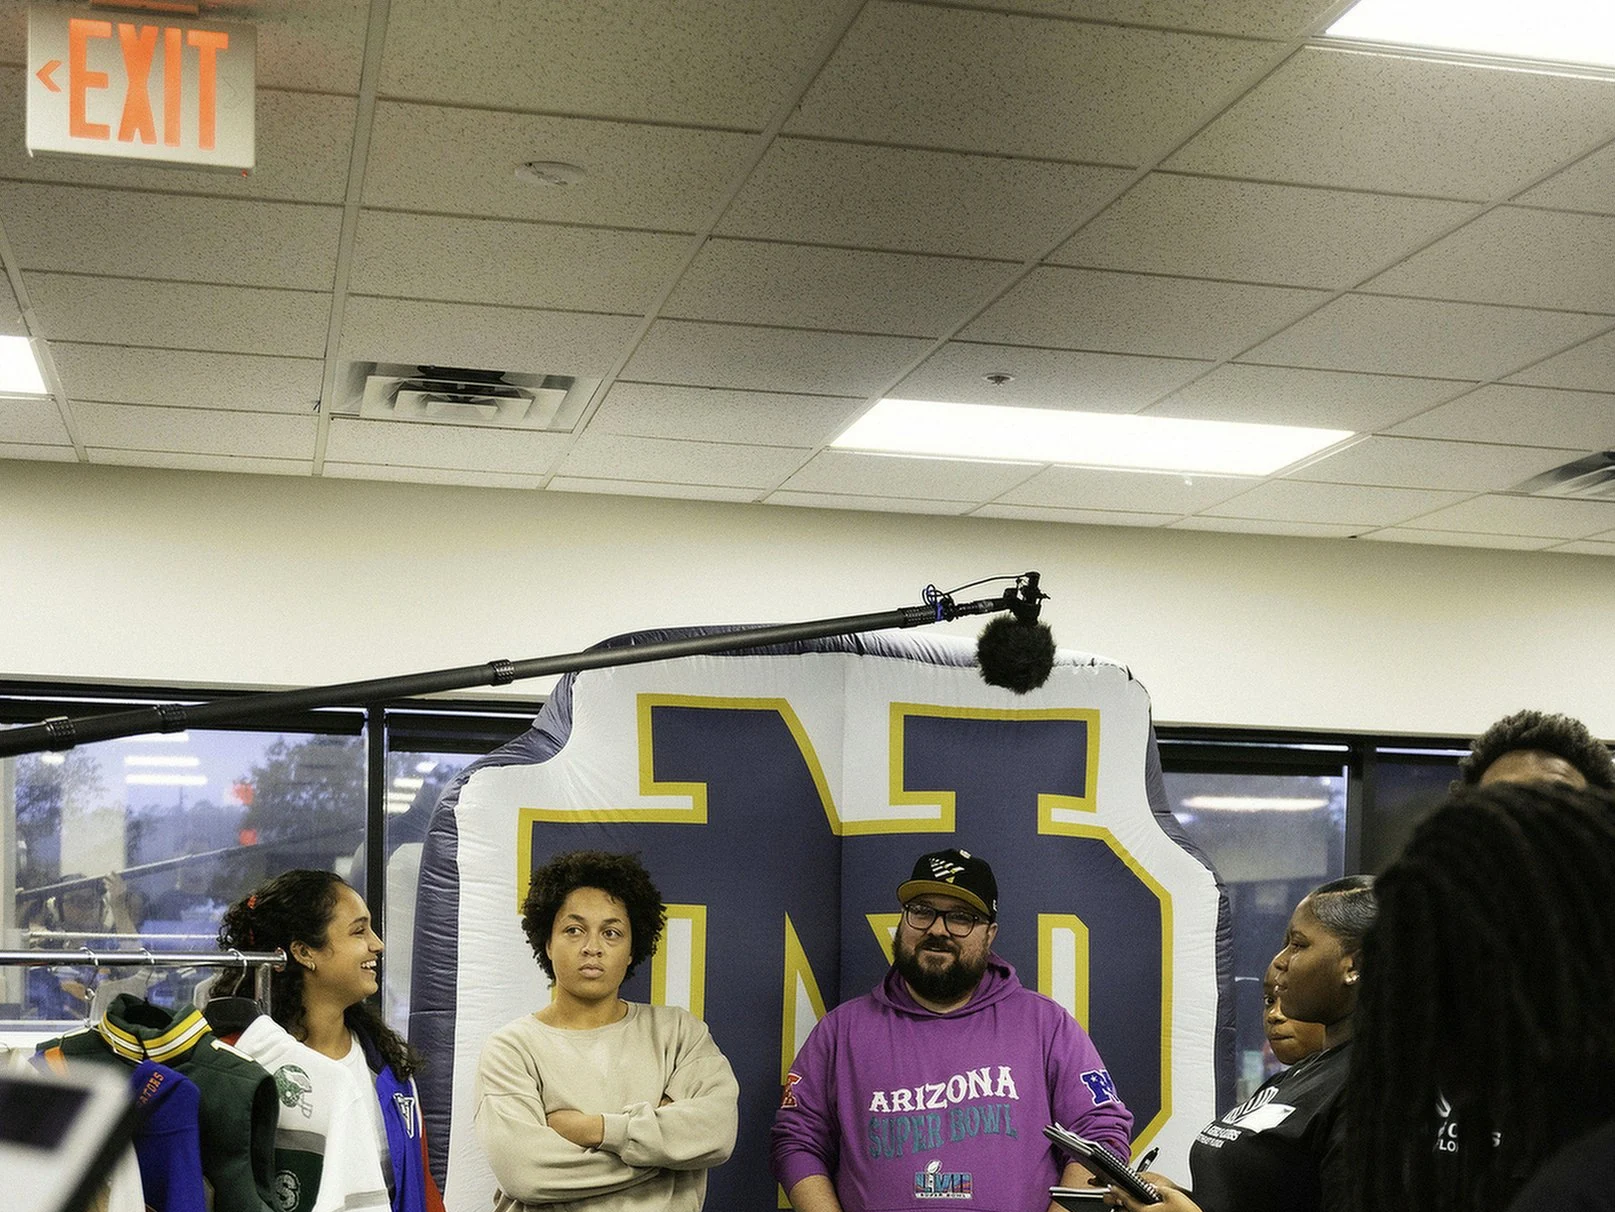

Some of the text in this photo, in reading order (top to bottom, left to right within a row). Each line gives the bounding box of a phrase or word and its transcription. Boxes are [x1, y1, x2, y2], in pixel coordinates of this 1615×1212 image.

[69, 18, 228, 149] EXIT
[869, 1066, 1019, 1113] ARIZONA
[868, 1103, 1018, 1159] SUPER BOWL
